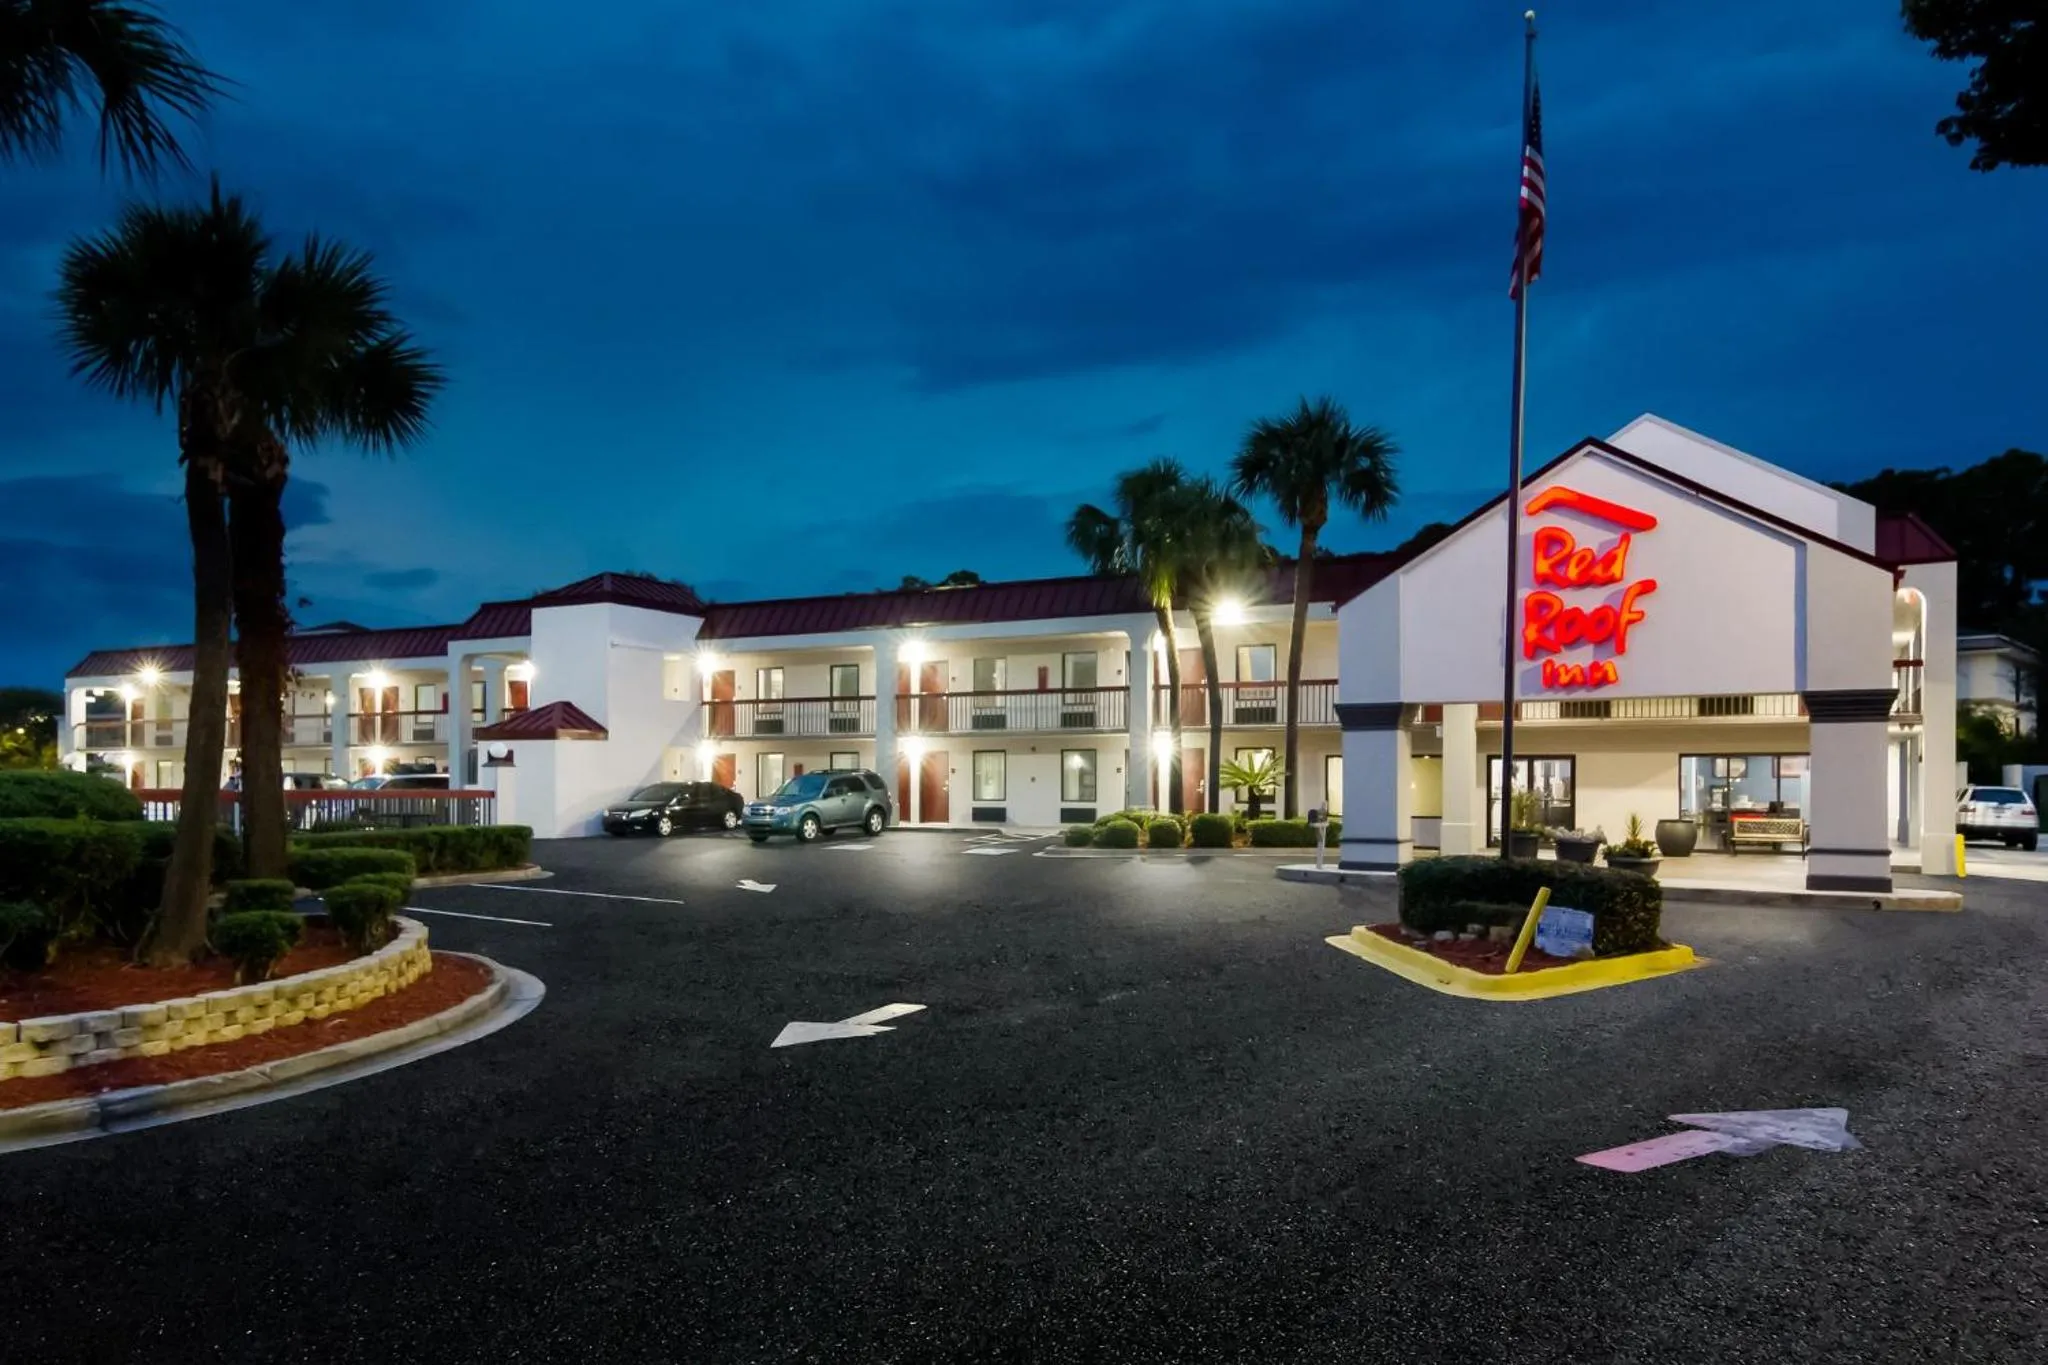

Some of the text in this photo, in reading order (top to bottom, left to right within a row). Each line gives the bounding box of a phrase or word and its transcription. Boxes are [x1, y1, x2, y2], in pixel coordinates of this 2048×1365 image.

[1533, 526, 1632, 588] Red
[1523, 578, 1657, 660] Roof
[1542, 658, 1619, 688] Inn
